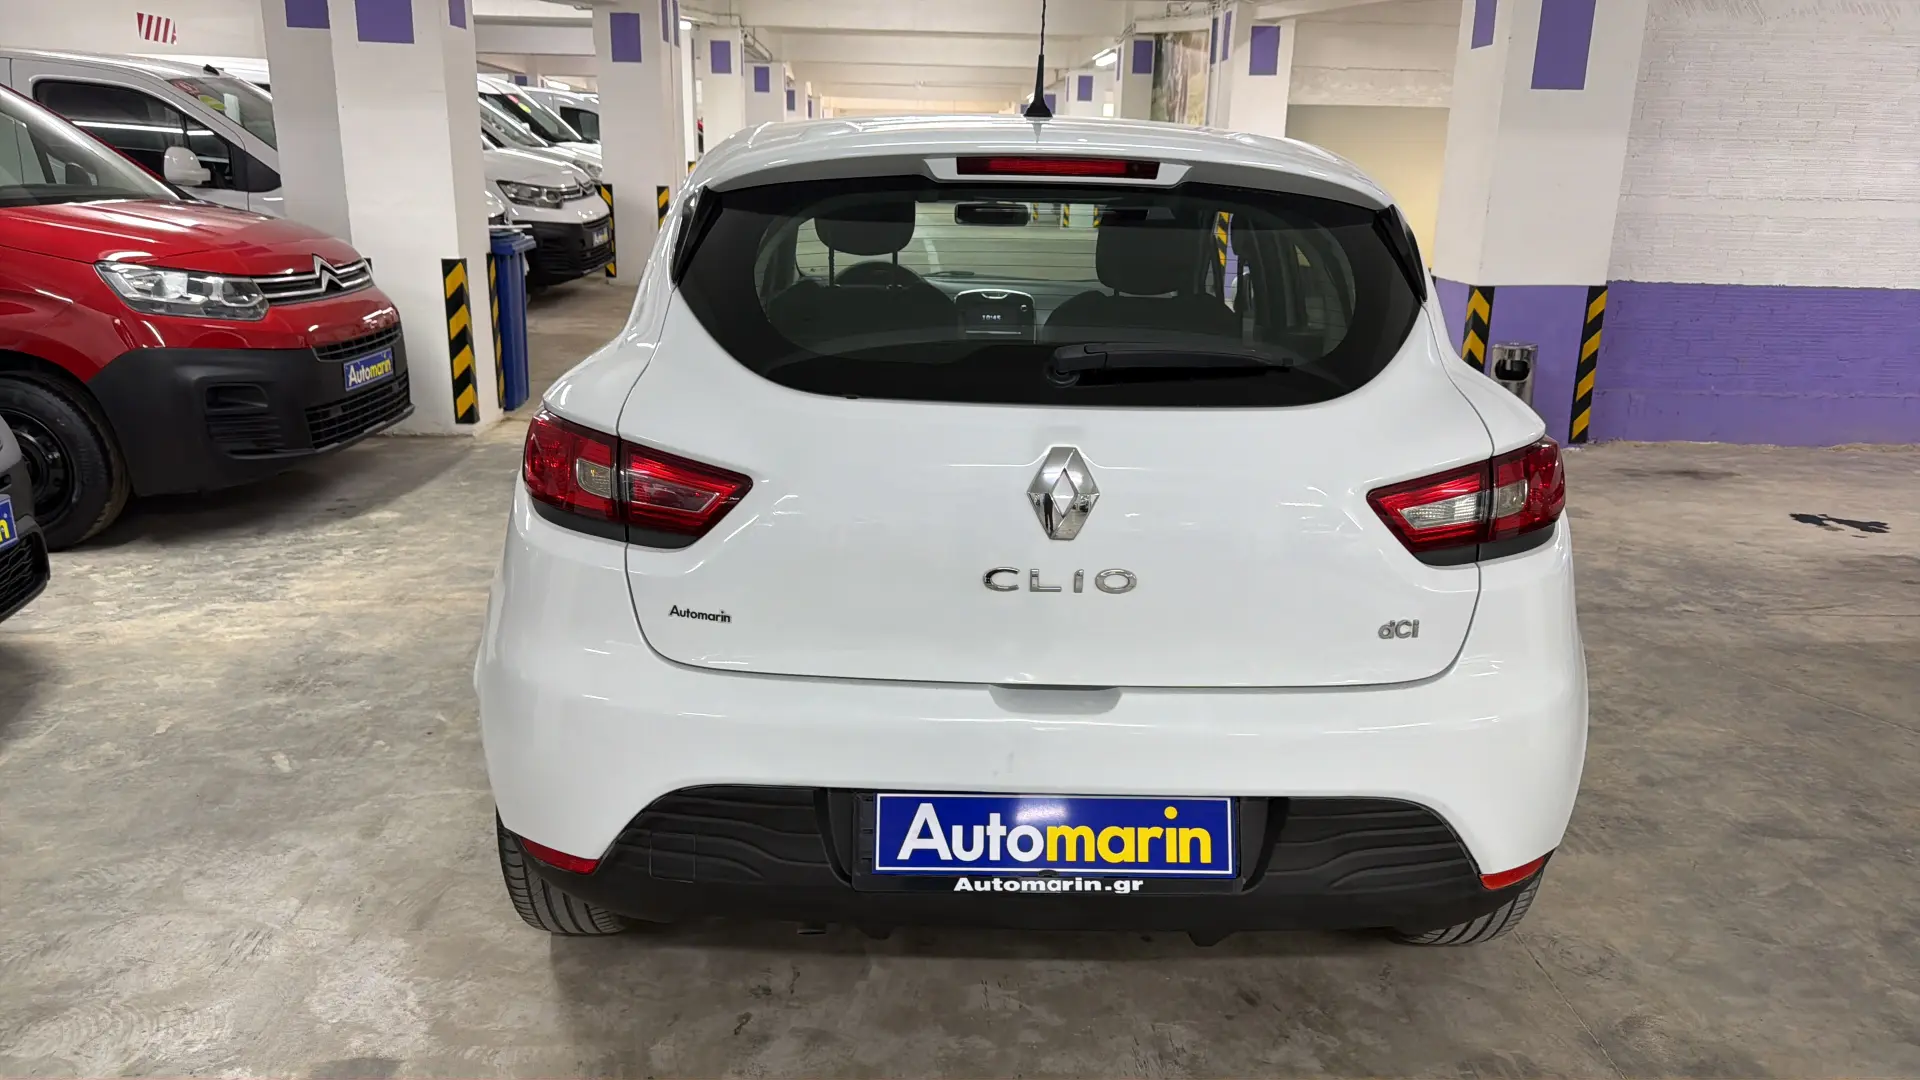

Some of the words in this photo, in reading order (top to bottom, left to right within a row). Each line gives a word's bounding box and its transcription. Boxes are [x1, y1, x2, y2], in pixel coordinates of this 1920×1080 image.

[348, 352, 391, 387] Automarin
[982, 566, 1138, 594] CLIO
[669, 604, 731, 622] Automarin
[896, 802, 1212, 864] Automarin
[953, 877, 1144, 894] Automarin.gr
